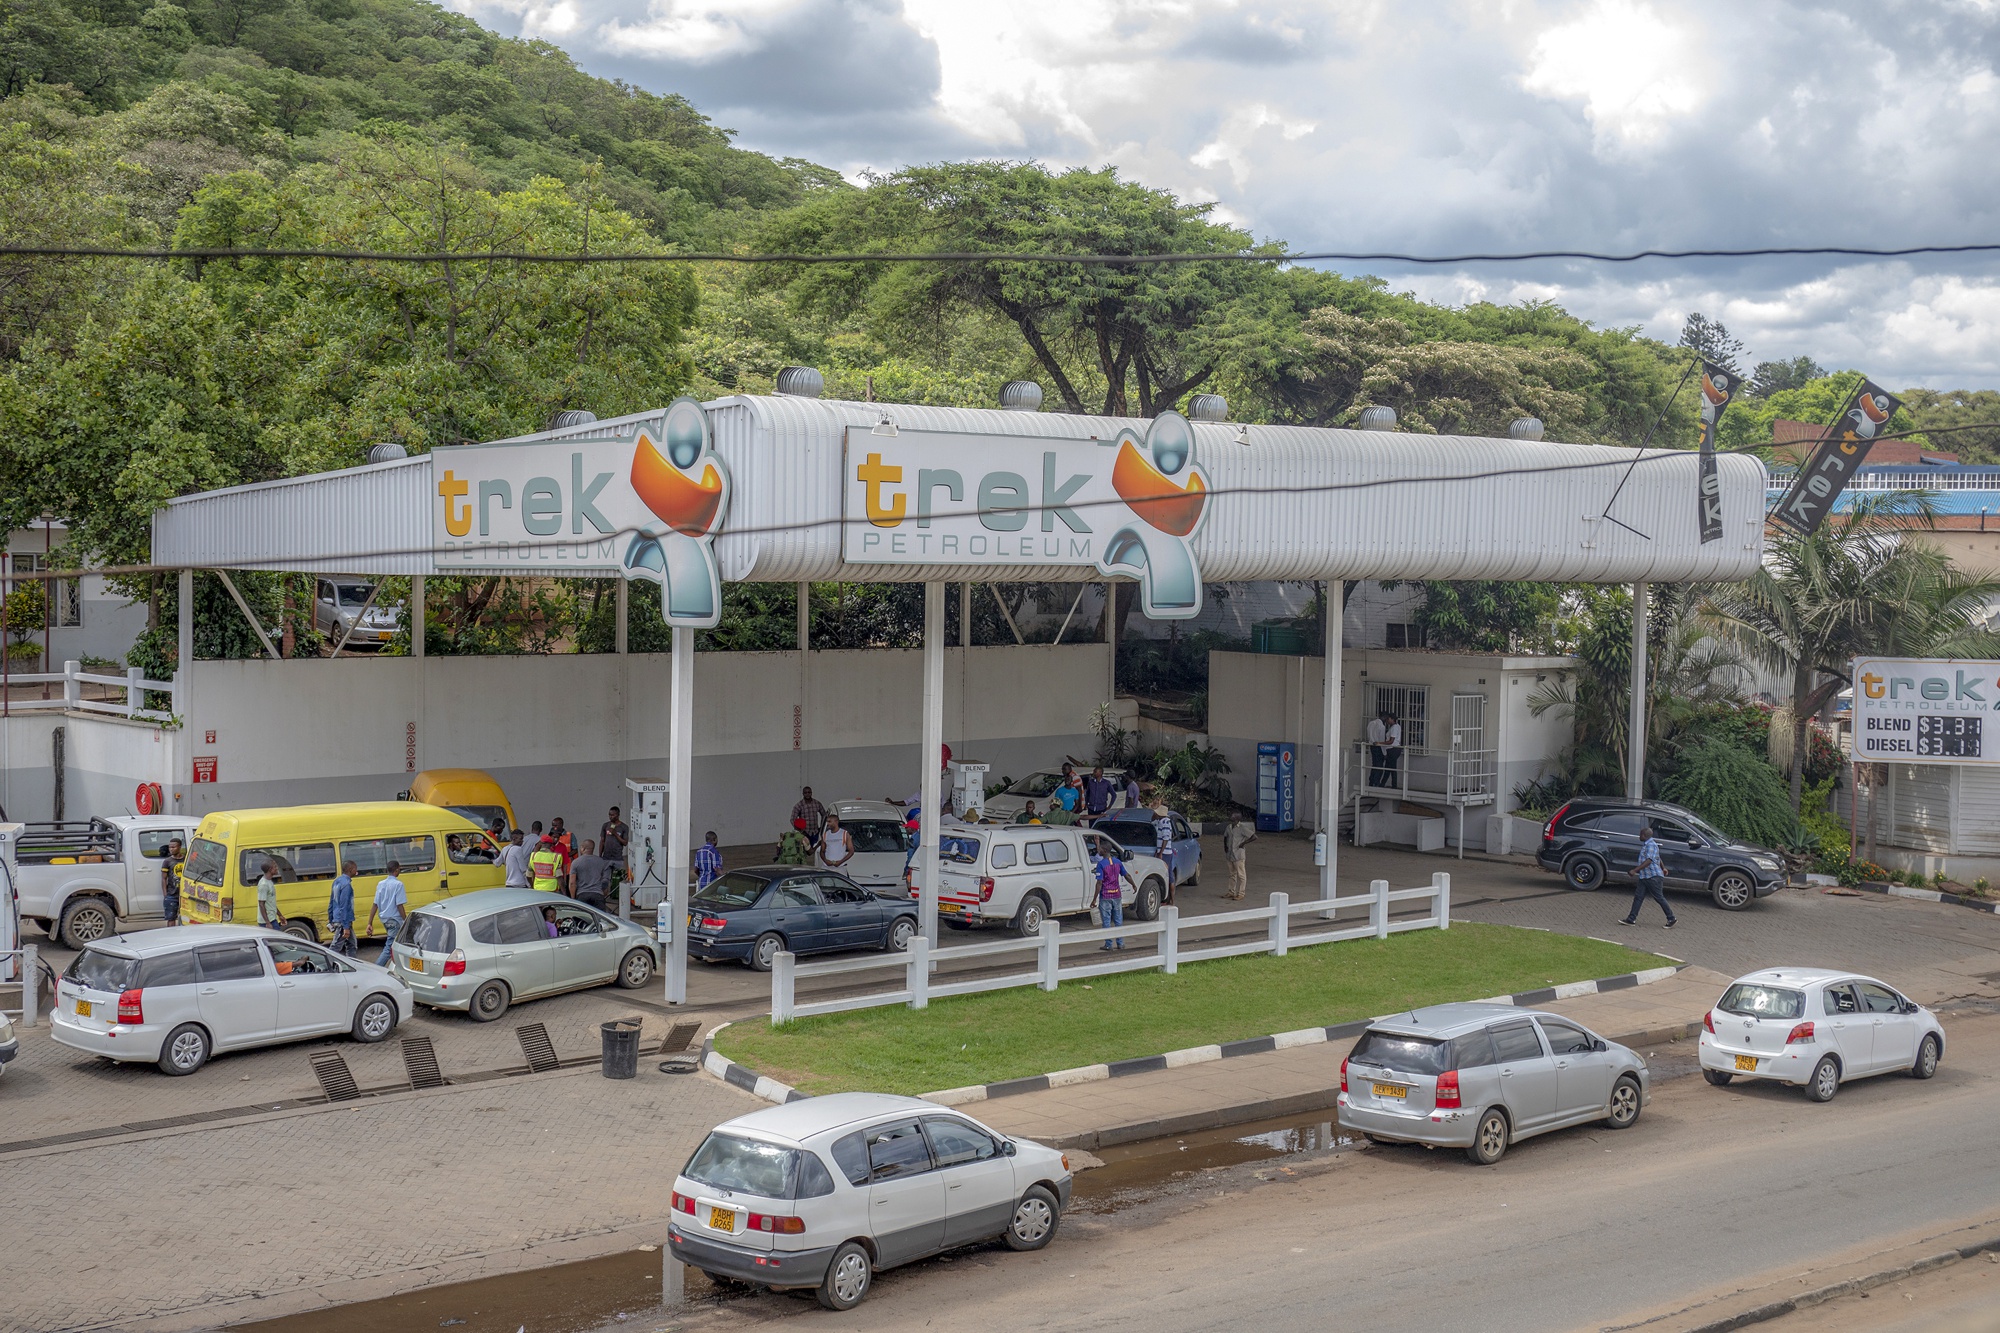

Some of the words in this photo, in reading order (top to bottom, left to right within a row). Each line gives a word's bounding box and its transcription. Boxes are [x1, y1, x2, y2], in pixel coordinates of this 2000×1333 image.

[1789, 430, 1860, 523] trek
[438, 452, 617, 537] trek
[857, 451, 1094, 534] trek
[444, 539, 616, 560] PETROLEUM
[863, 532, 1092, 558] PETROLEUM
[1860, 670, 1986, 702] trek
[1865, 701, 1988, 711] PETROLEUM
[1867, 718, 1911, 731] BLEND
[1867, 738, 1914, 752] DIESEL
[1282, 775, 1293, 822] pepsi
[714, 1218, 731, 1230] 8265
[717, 1209, 731, 1220] ABH
